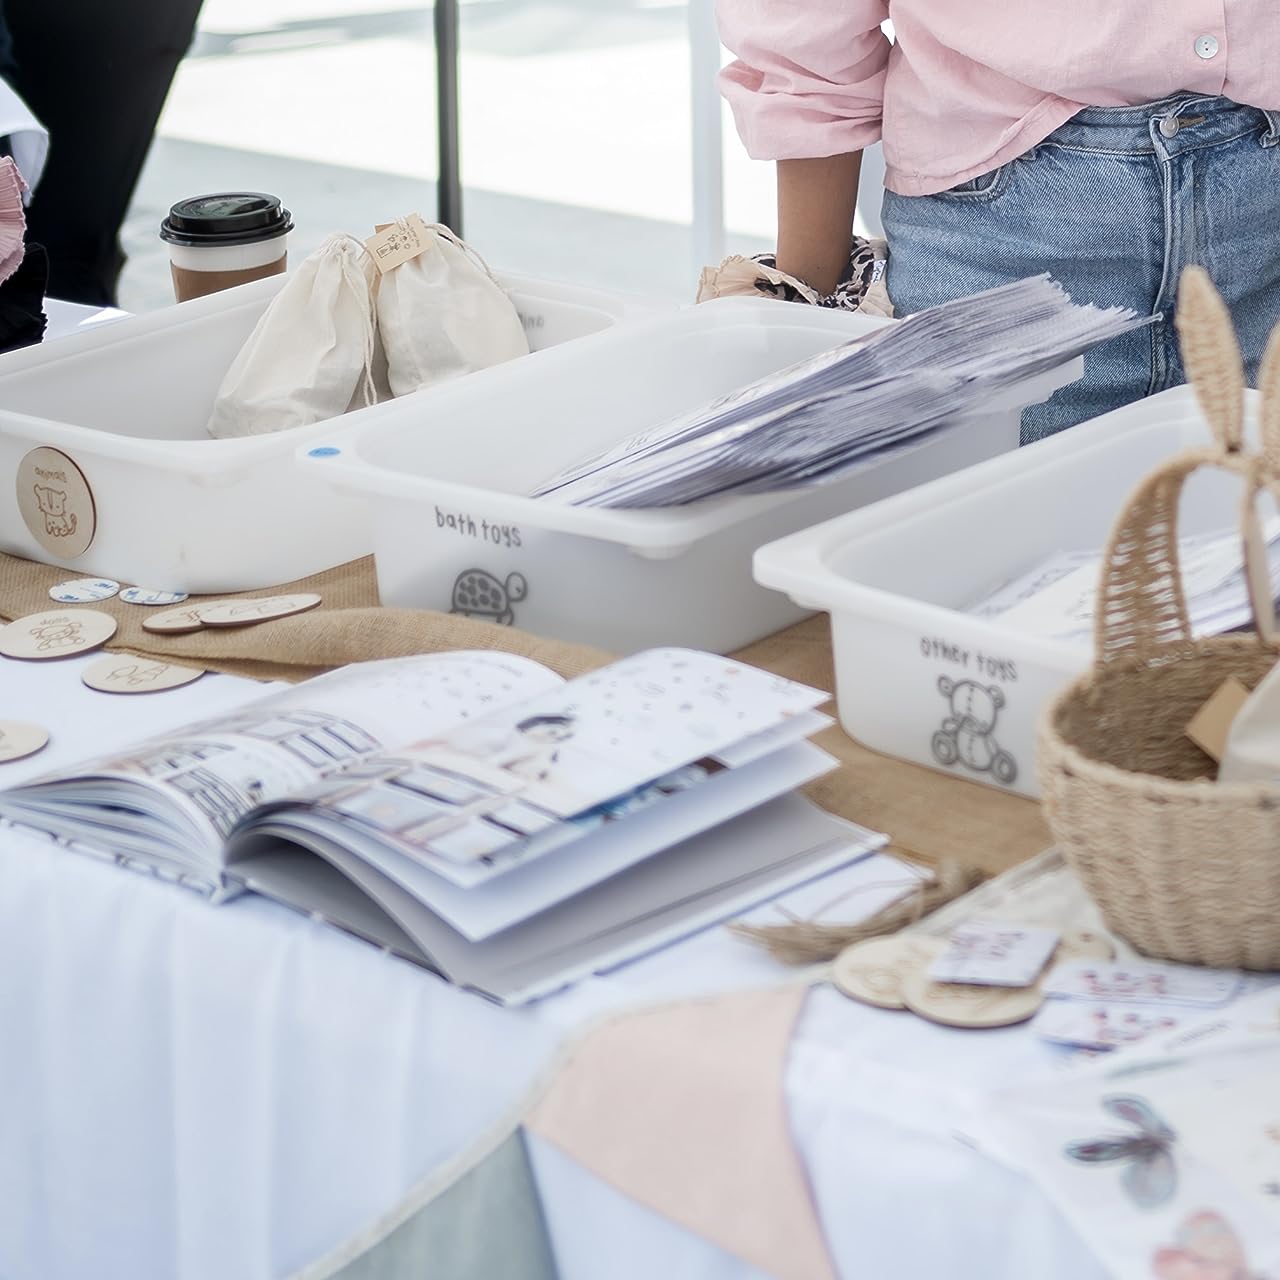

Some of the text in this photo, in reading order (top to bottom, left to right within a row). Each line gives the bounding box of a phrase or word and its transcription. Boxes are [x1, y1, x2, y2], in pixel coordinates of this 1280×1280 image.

[434, 505, 522, 548] bath toys
[920, 637, 1017, 681] other toys
